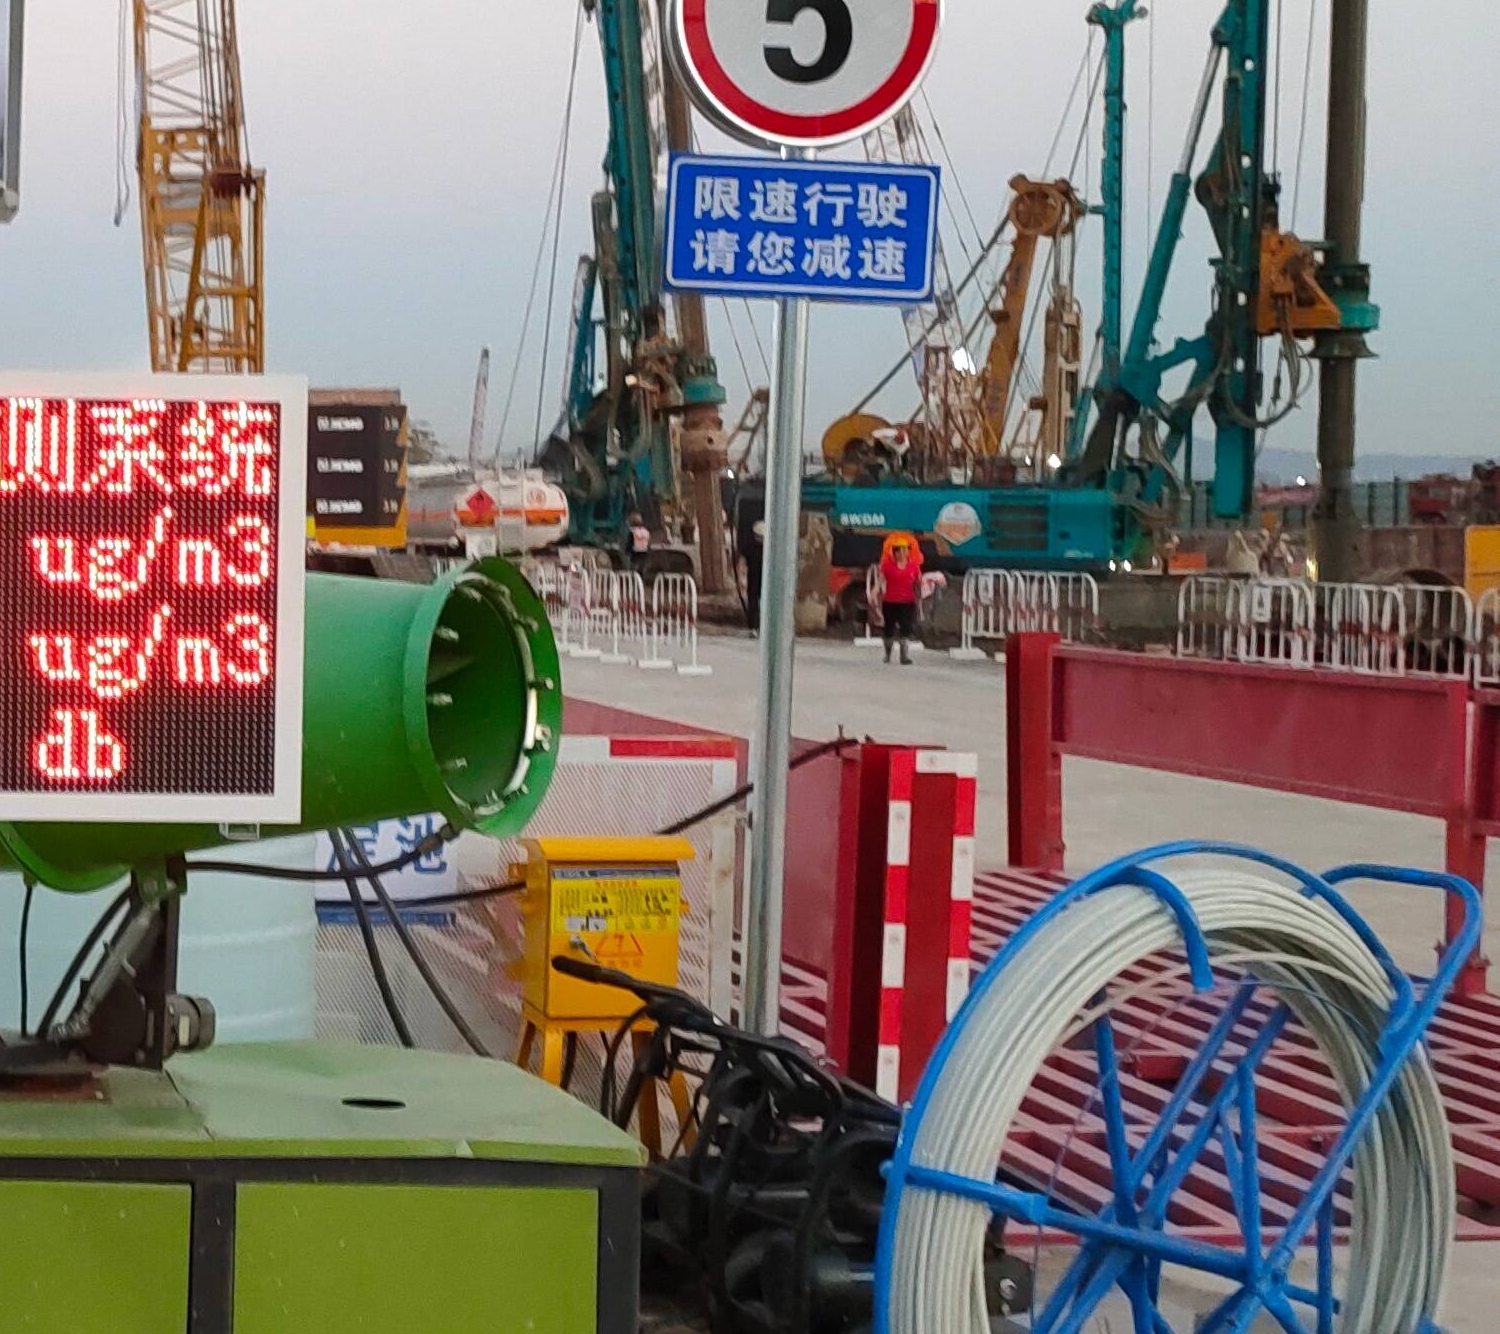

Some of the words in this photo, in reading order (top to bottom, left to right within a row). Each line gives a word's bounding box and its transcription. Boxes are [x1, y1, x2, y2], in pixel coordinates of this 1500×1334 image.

[693, 175, 908, 228] 限速行驶
[690, 229, 907, 282] 请您减速
[30, 506, 272, 600] ug/m3
[30, 603, 272, 699] ug/m3
[34, 707, 128, 780] db
